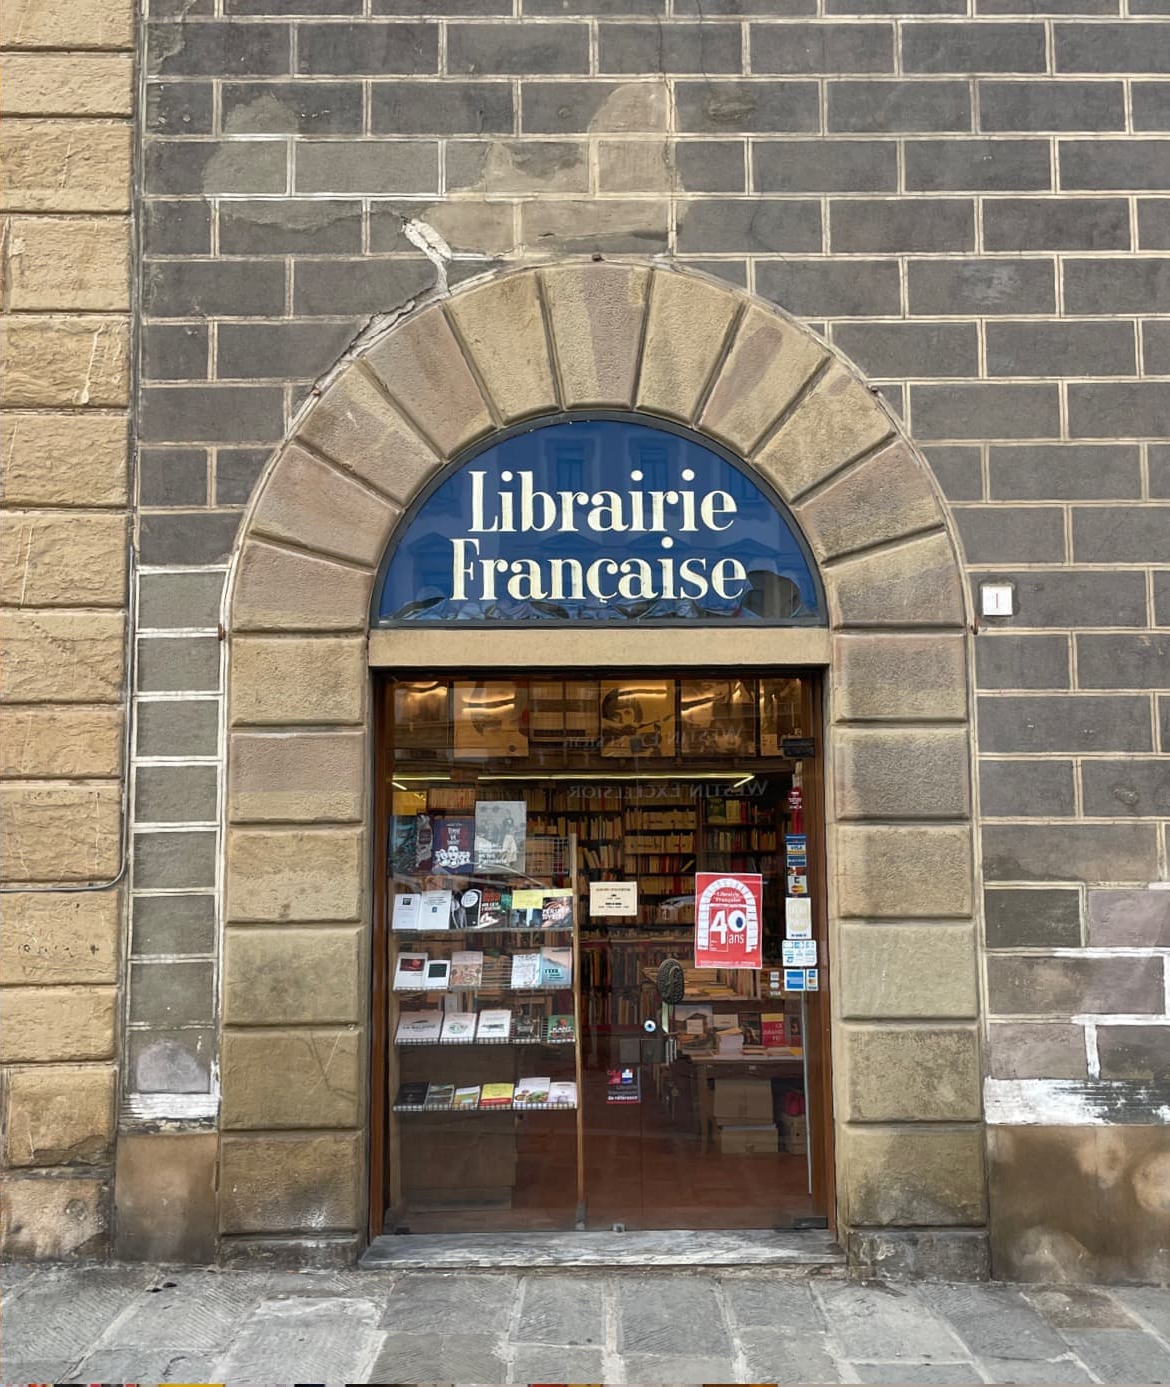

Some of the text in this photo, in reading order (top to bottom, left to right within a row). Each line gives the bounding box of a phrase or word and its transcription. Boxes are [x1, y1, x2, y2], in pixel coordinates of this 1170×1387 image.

[468, 469, 738, 533] Librairie
[449, 537, 747, 604] Française
[710, 910, 747, 944] 40
[728, 933, 744, 944] ans
